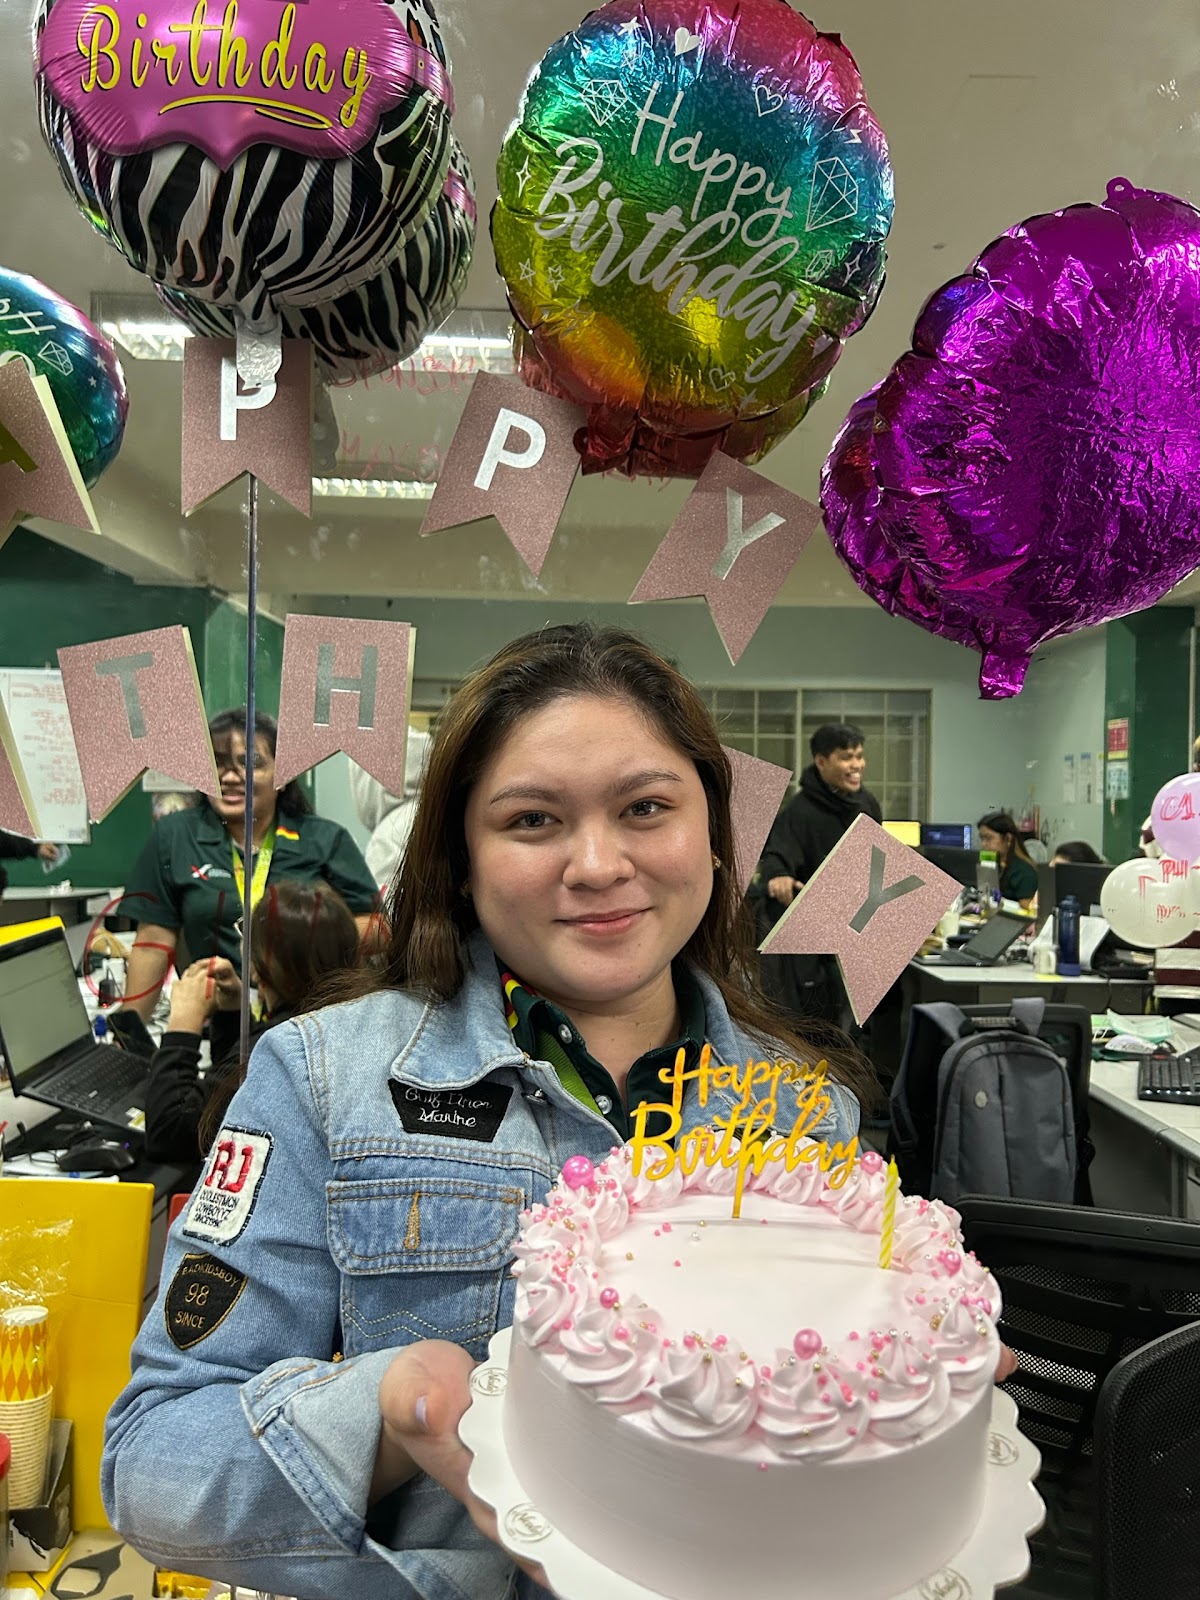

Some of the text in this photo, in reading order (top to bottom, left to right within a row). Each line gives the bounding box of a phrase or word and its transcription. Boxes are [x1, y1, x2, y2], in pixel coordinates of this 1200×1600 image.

[76, 0, 371, 128] Birthday
[630, 80, 793, 247] Happy
[534, 137, 816, 383] Birthday
[95, 642, 927, 935] T H Y
[418, 1107, 477, 1128] Marine
[658, 1043, 831, 1114] Happy
[204, 1139, 255, 1194] RJ
[630, 1099, 861, 1190] Birthday
[174, 1310, 206, 1329] SINCE
[184, 1282, 210, 1306] 98
